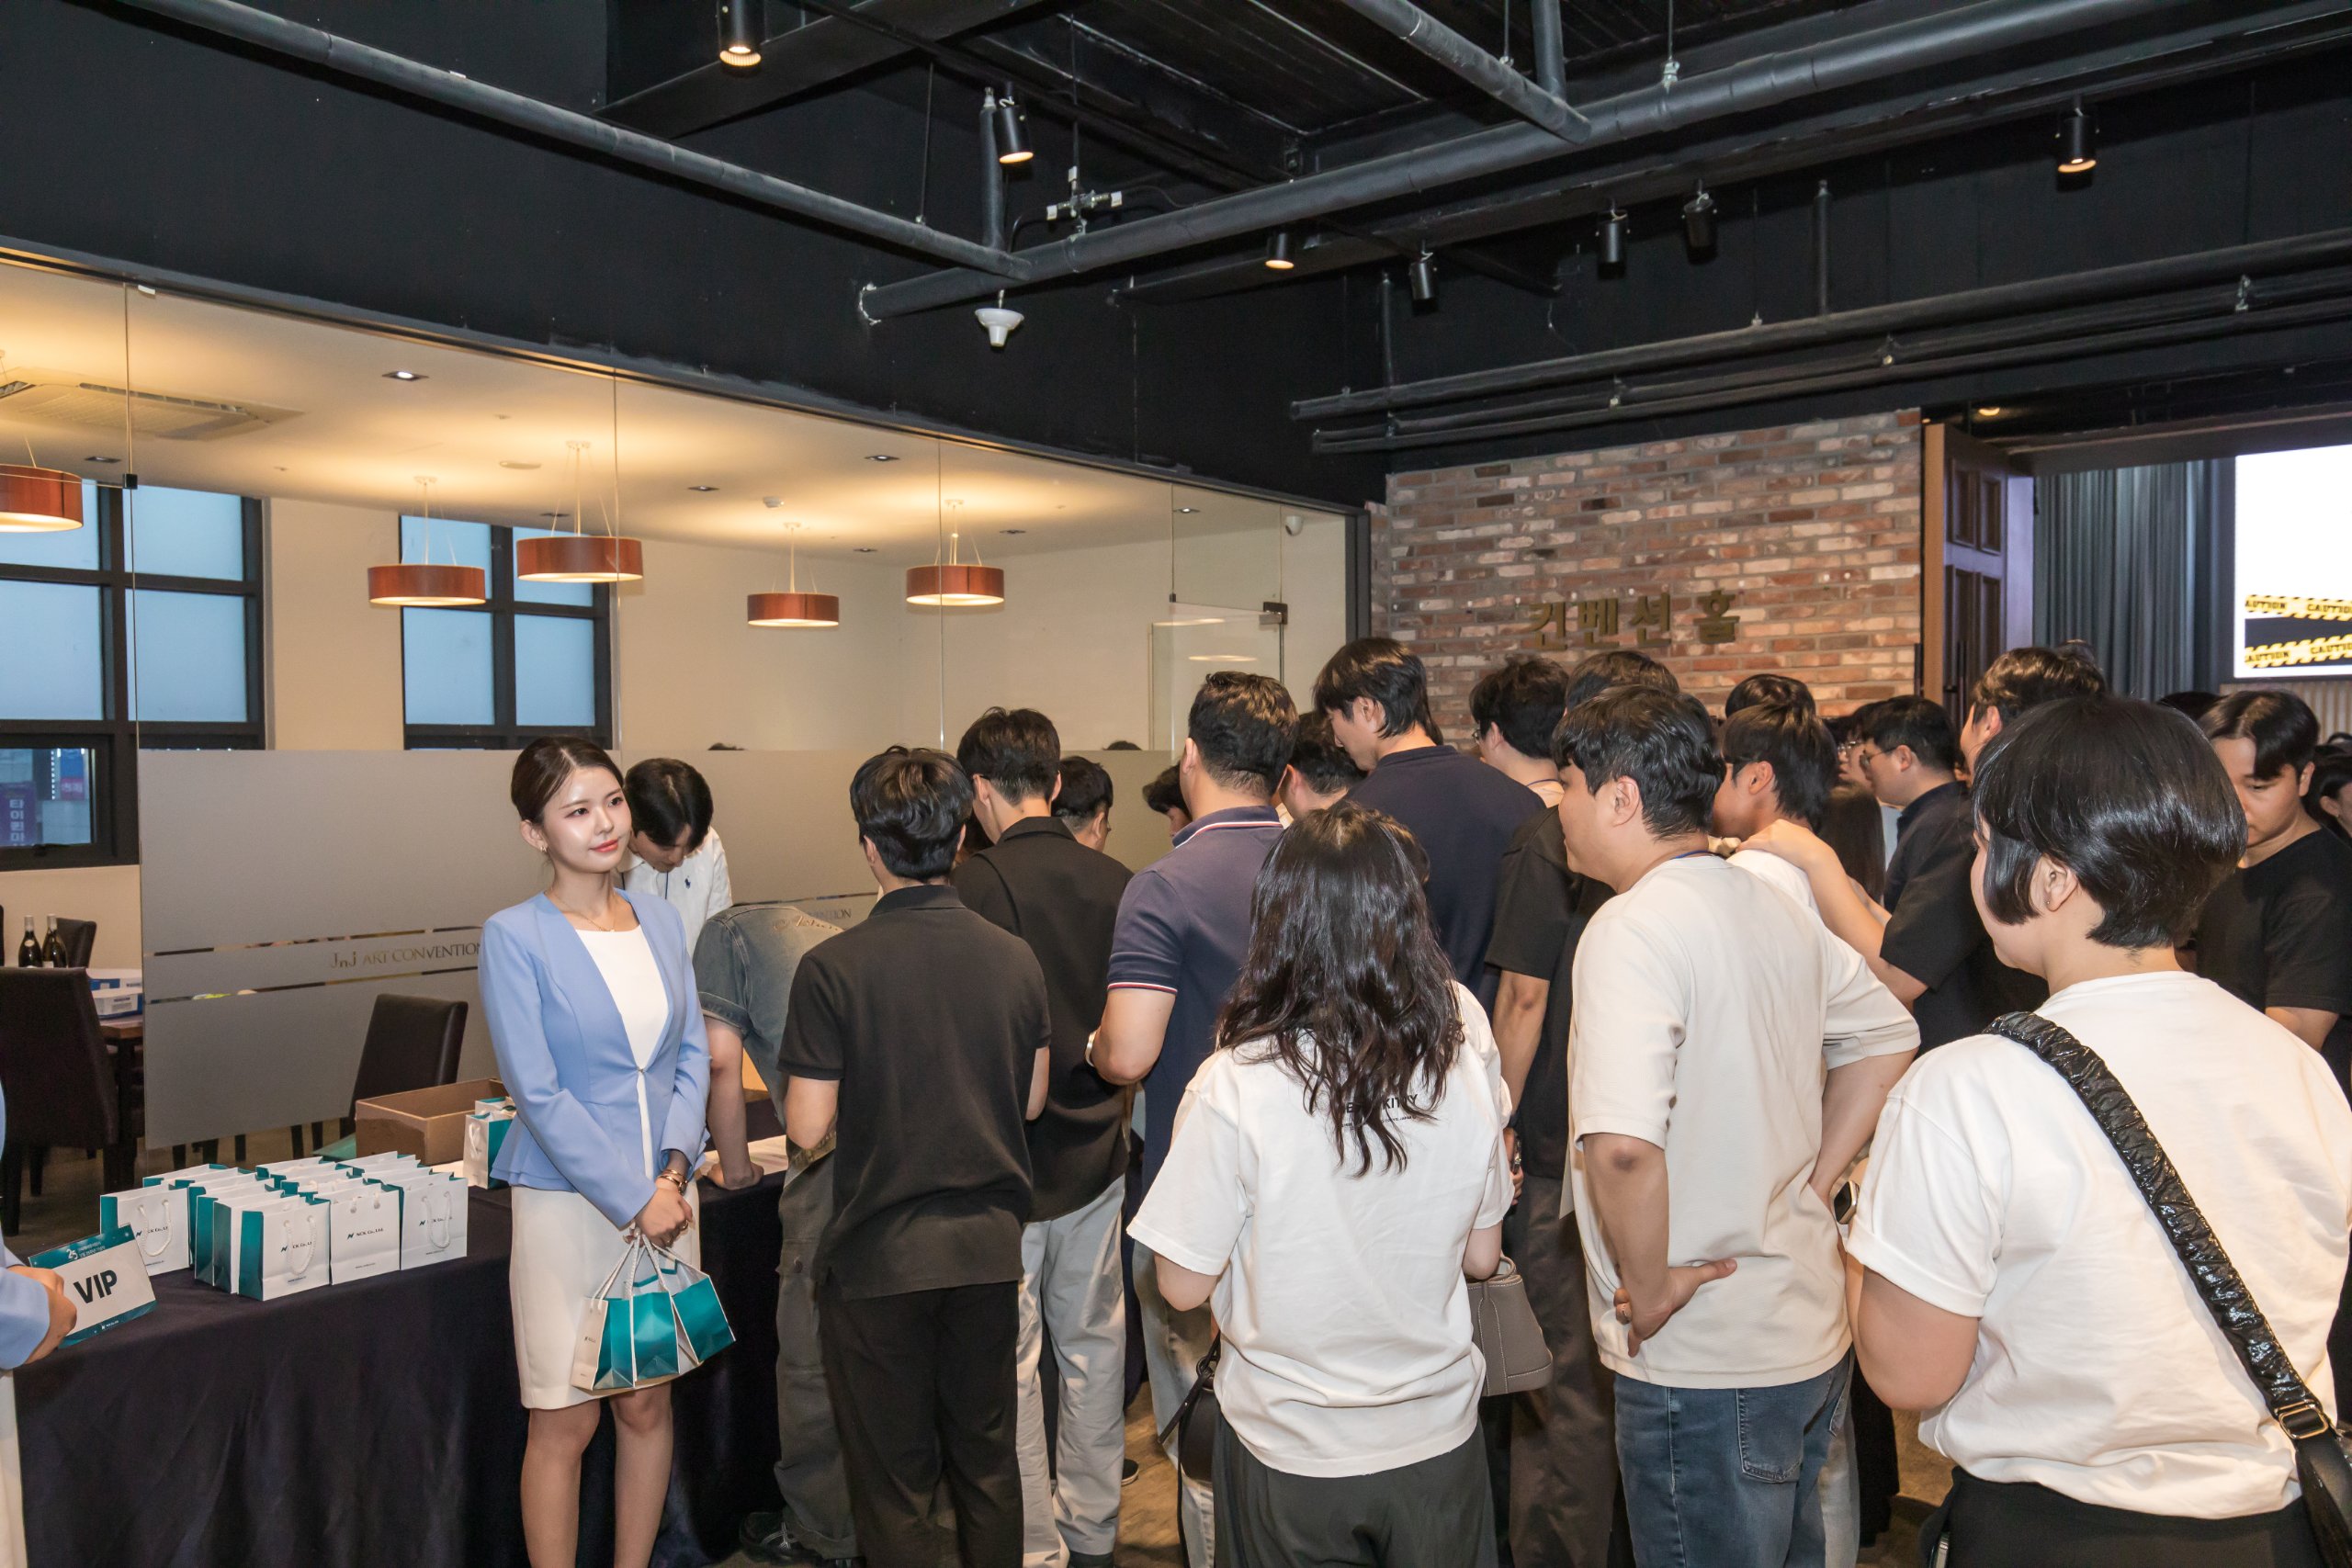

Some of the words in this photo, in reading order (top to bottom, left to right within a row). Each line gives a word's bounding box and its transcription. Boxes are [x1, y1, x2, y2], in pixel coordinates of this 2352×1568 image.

[362, 951, 388, 964] ART
[1383, 1094, 1419, 1110] KITY
[73, 1269, 118, 1303] VIP
